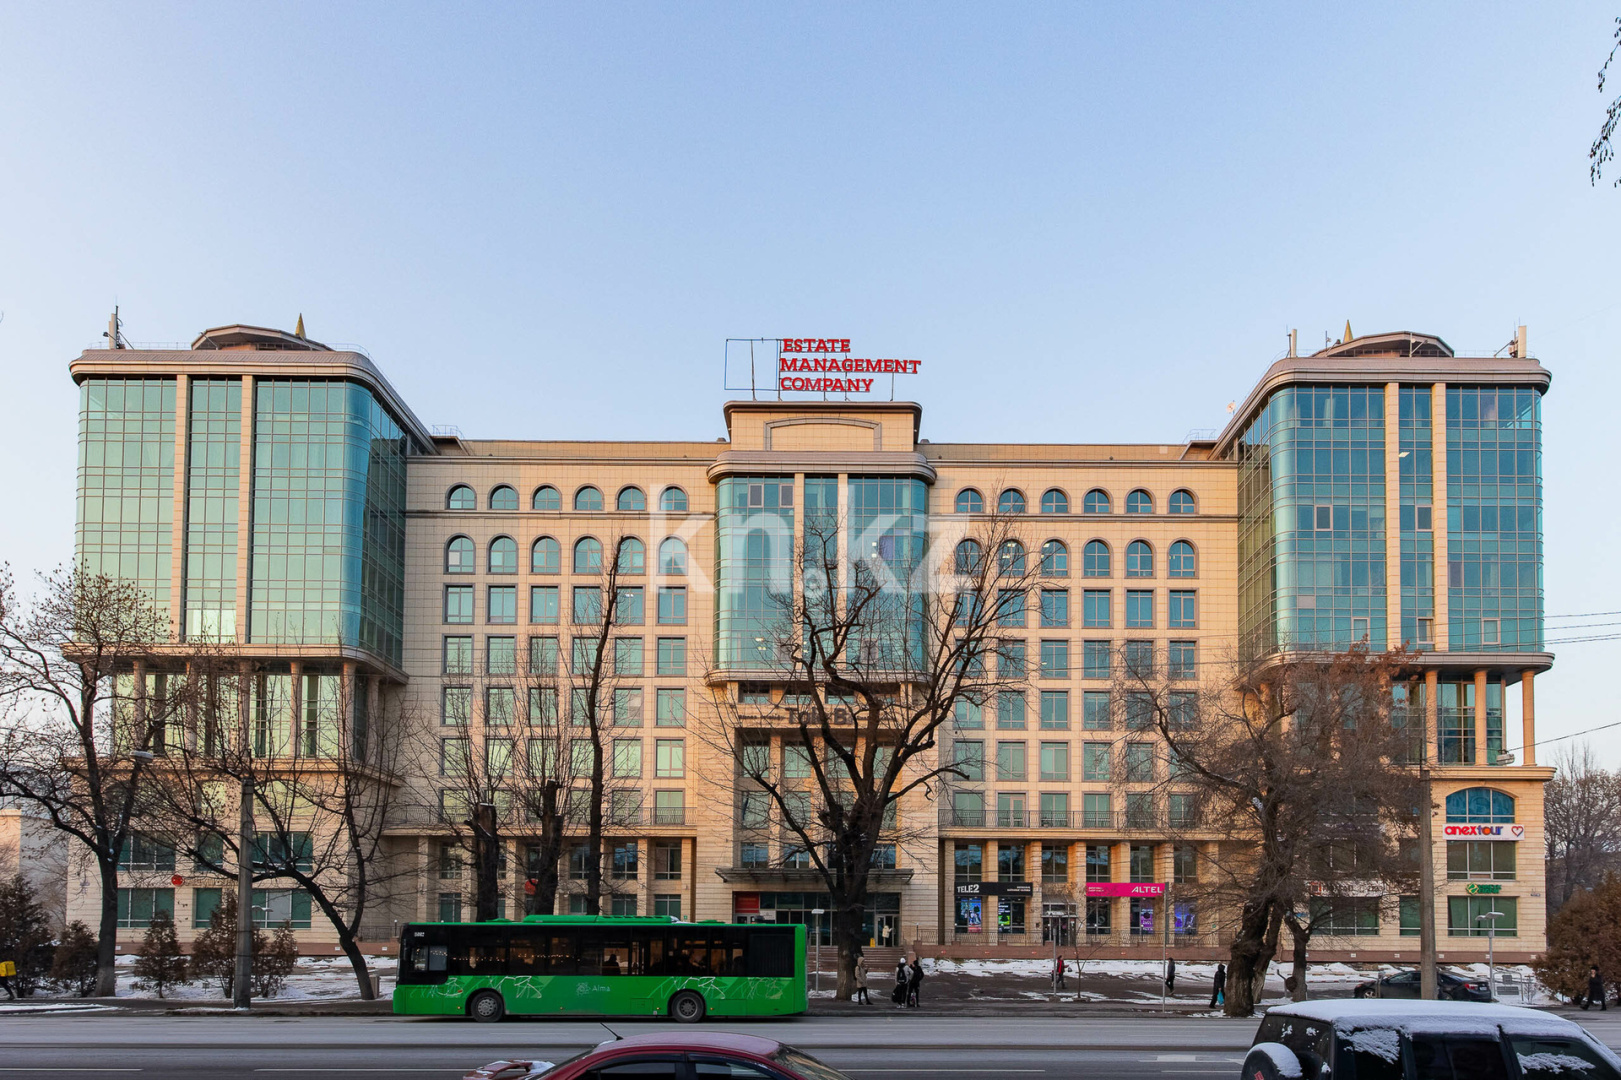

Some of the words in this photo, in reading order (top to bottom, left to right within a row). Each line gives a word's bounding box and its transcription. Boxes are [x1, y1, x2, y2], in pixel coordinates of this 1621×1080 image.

[783, 338, 851, 353] ESTATE
[780, 357, 922, 374] MANAGEMENT
[780, 377, 874, 392] COMPANY
[956, 884, 980, 893] TELE2
[1131, 886, 1163, 894] ALTEL
